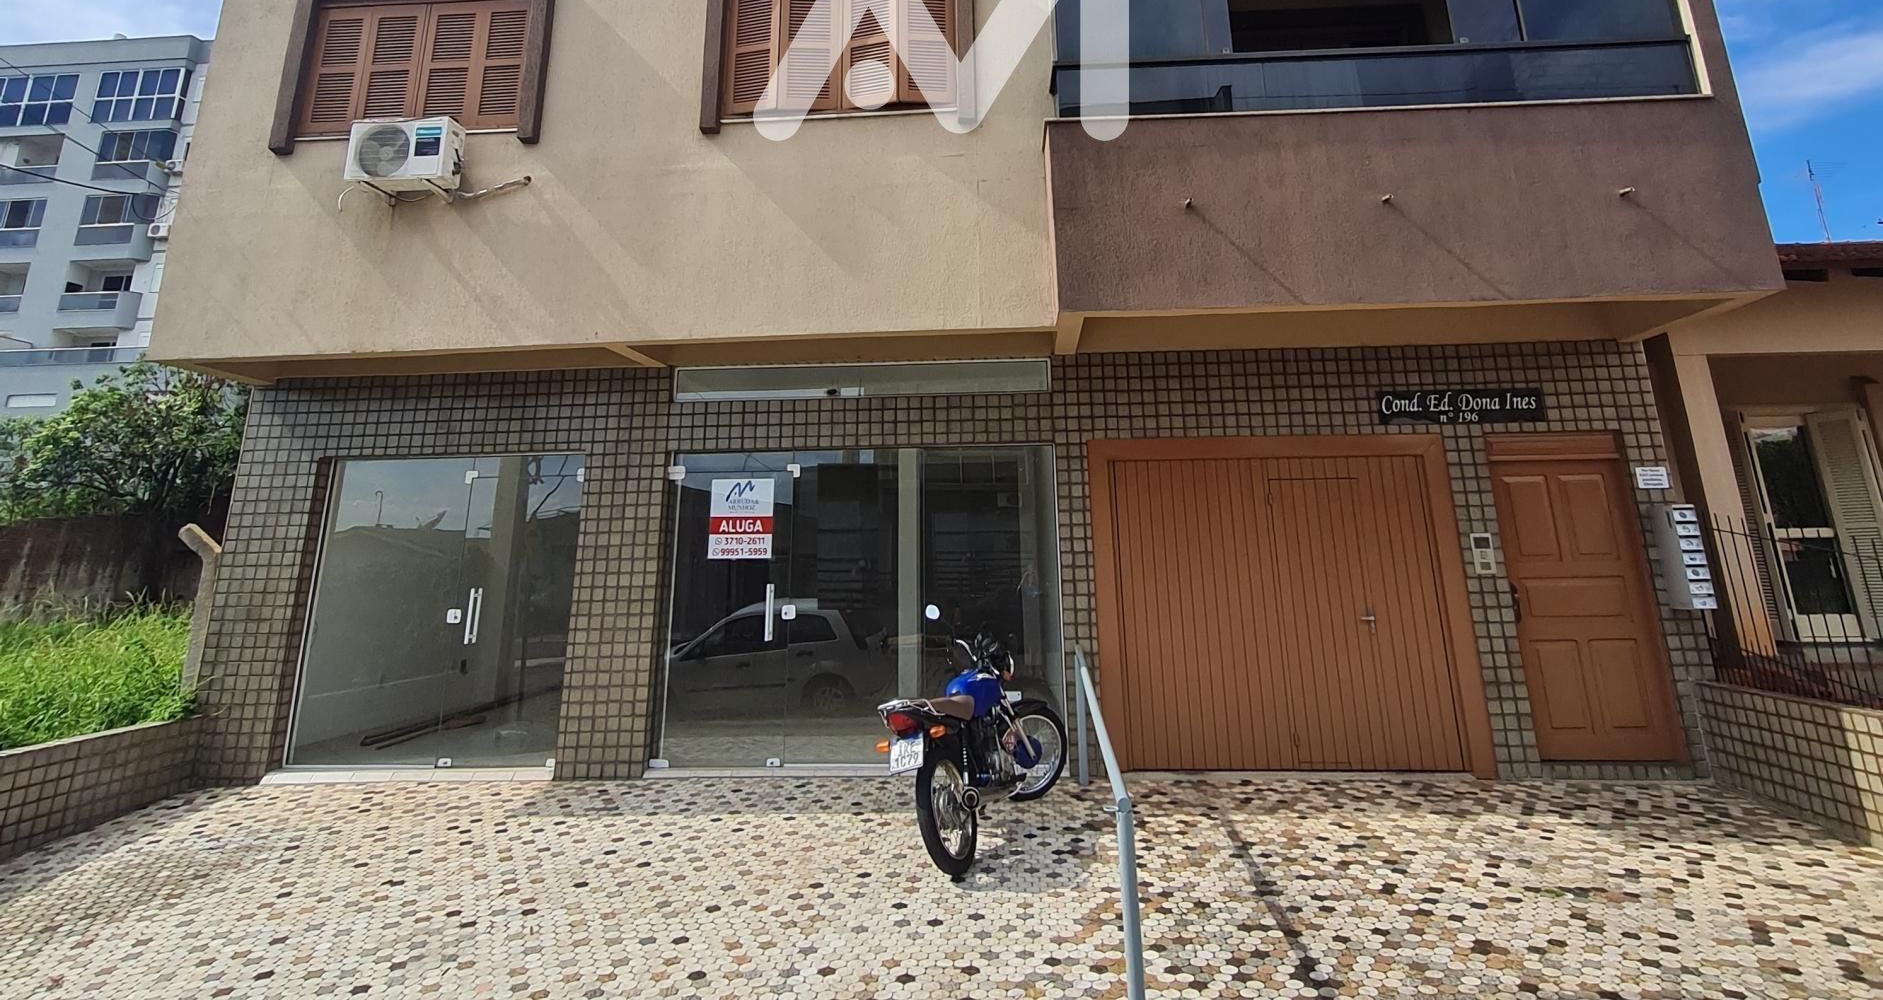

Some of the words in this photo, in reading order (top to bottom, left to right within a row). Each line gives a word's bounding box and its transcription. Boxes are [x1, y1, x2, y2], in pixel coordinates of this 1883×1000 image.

[1381, 392, 1422, 414] Cond.
[1426, 391, 1454, 412] Ed.
[1457, 393, 1500, 411] Dona
[1505, 392, 1537, 410] Ines
[1458, 411, 1479, 423] 196
[719, 519, 764, 533] ALUGA
[724, 537, 766, 546] 3710-2611
[720, 547, 768, 557] 99951-5959
[895, 752, 919, 768] 1C79
